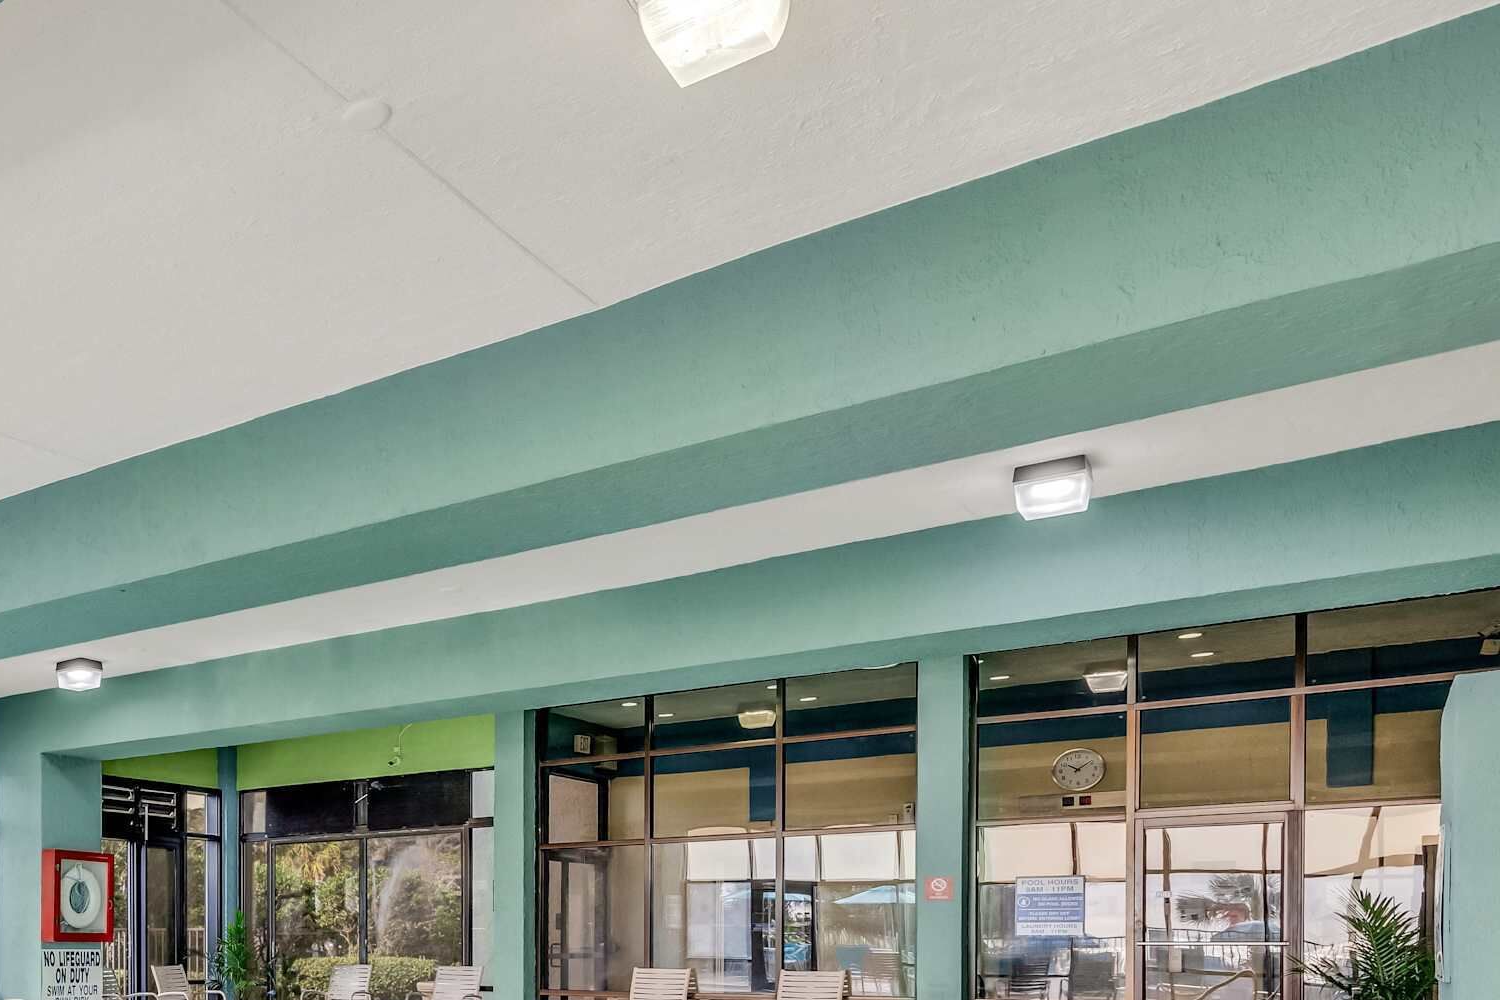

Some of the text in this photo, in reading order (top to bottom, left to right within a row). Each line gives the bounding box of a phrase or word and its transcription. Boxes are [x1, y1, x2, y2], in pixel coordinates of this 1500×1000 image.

[44, 951, 100, 966] NO LIFEGUARD
[56, 968, 89, 983] ON DUTY
[47, 985, 98, 996] SWIM AT YOUR
